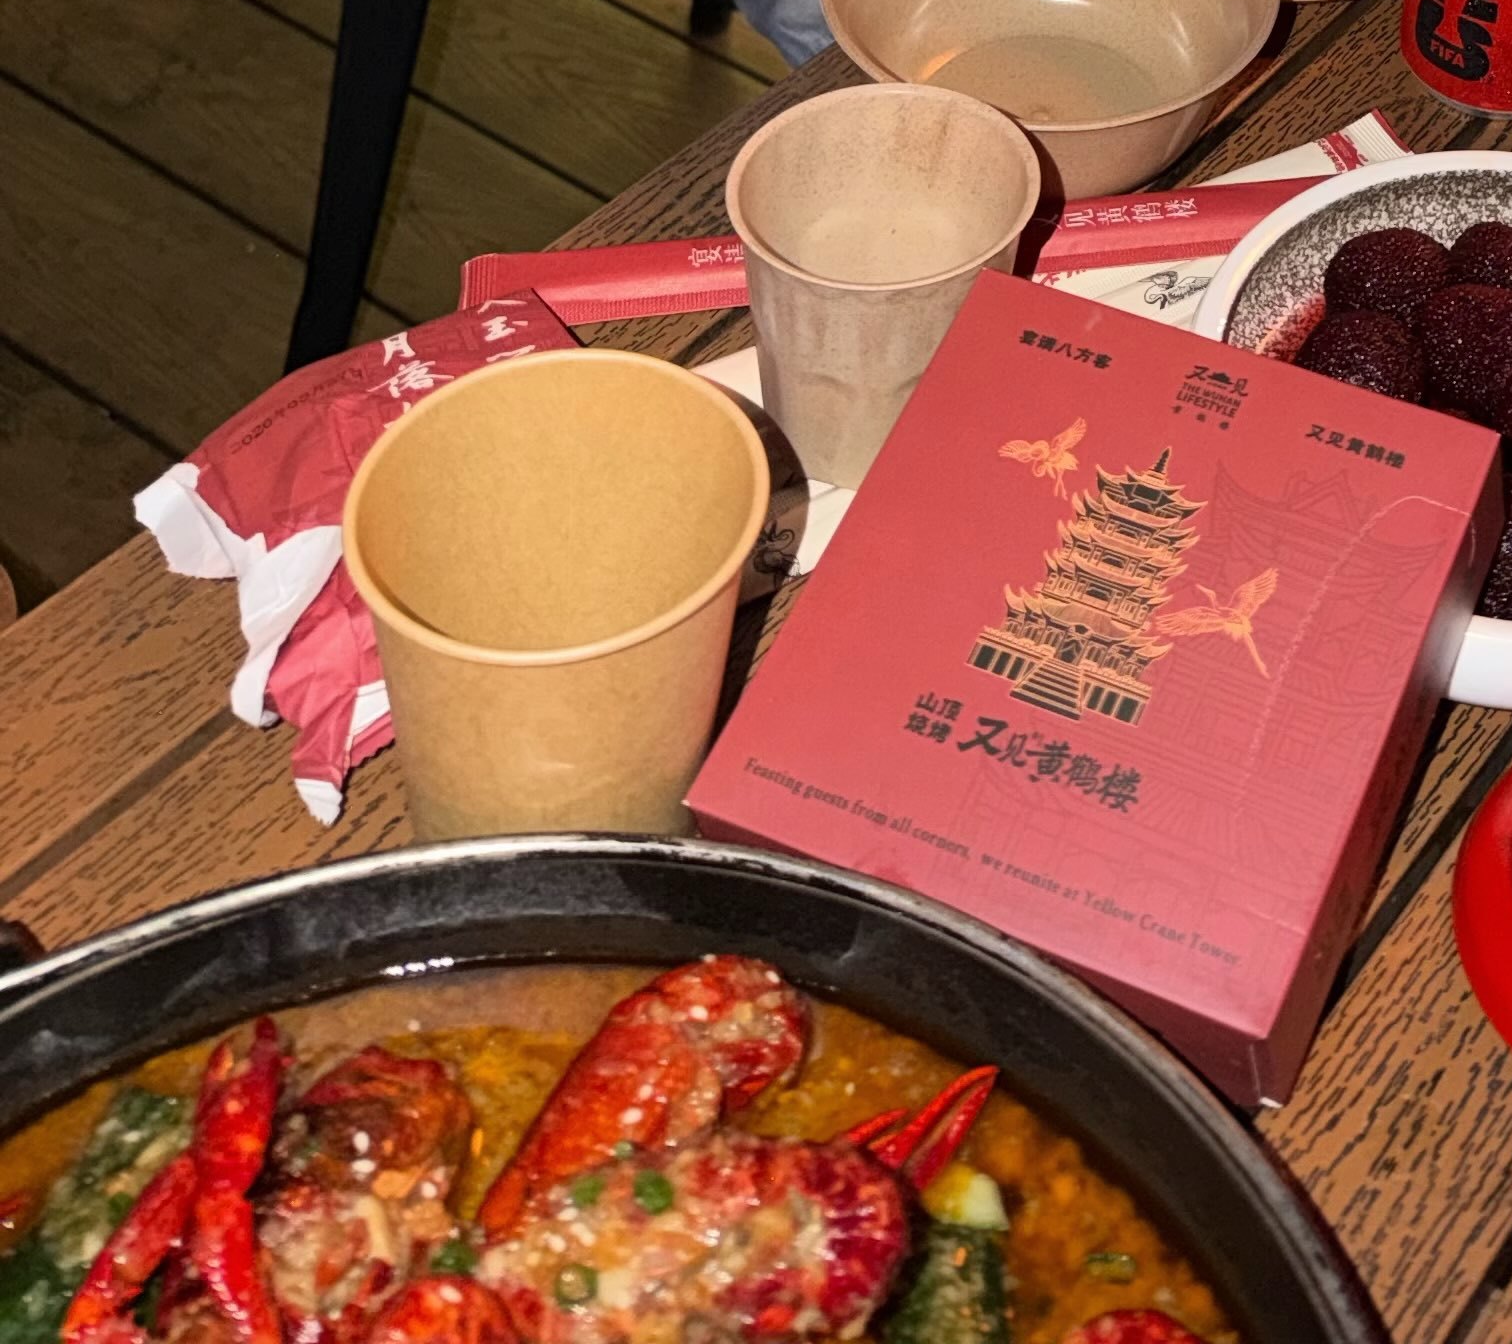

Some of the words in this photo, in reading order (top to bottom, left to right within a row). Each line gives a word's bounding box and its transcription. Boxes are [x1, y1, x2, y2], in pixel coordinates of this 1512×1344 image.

[1430, 39, 1466, 69] FIFA
[1182, 381, 1201, 393] THE
[1176, 390, 1237, 418] LIFESTYLE
[915, 691, 964, 721] 山顶
[904, 711, 953, 743] 烧烤
[956, 715, 1141, 813] 又见黄鹤楼
[744, 757, 804, 795] Feasting
[803, 784, 849, 810] guests
[851, 799, 888, 826] from
[889, 817, 914, 833] all
[980, 853, 1003, 871] we
[1004, 862, 1061, 893] reunite
[1063, 887, 1079, 901] at
[1083, 890, 1137, 922] Yellow
[1139, 914, 1186, 944] Crane
